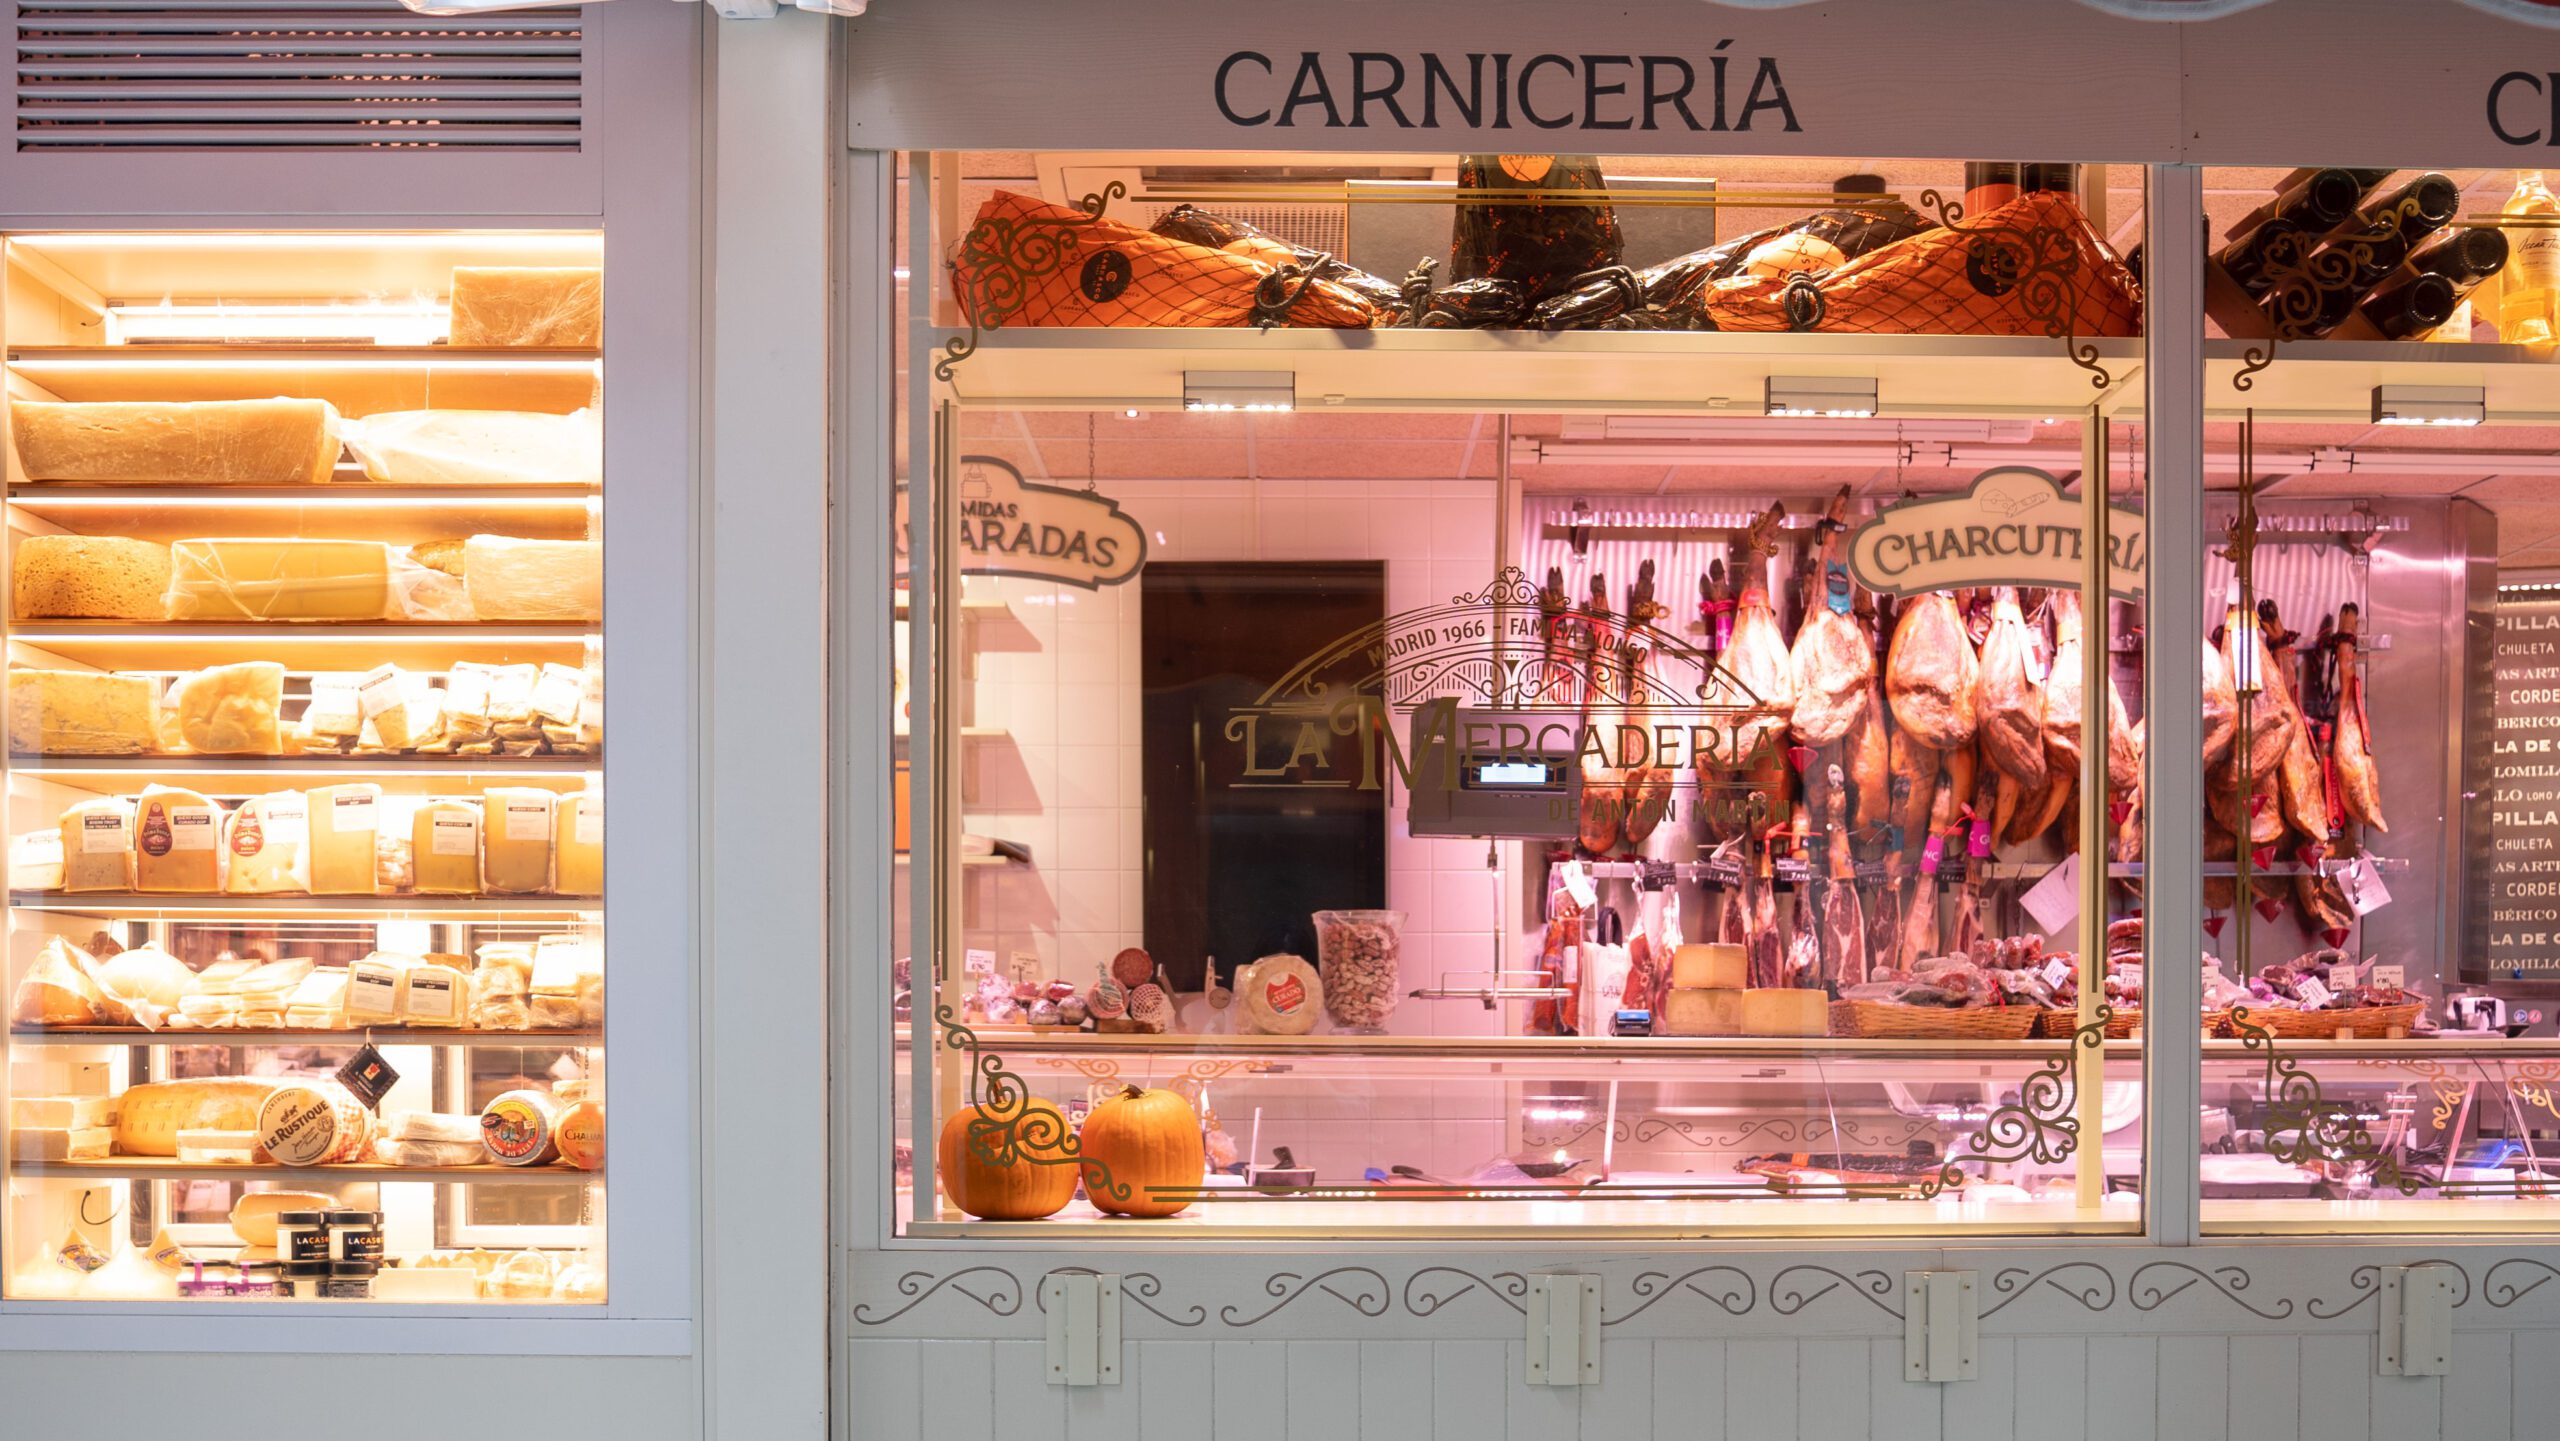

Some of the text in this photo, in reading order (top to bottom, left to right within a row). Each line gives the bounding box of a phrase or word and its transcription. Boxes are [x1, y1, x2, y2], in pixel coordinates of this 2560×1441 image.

[1214, 39, 1803, 133] CARNICERÍA
[1367, 628, 1437, 668] MADRID
[1442, 619, 1486, 644] 1966
[2498, 642, 2555, 656] CHULETA
[2523, 667, 2560, 680] ART
[2525, 739, 2551, 753] DE
[2527, 791, 2553, 801] LOMO
[1550, 800, 1578, 821] DE
[2496, 837, 2553, 850] CHULETA
[2506, 881, 2560, 898] CORDE
[2521, 932, 2547, 946] DE
[264, 1137, 280, 1151] LE
[275, 1099, 330, 1142] RUSTIQUE
